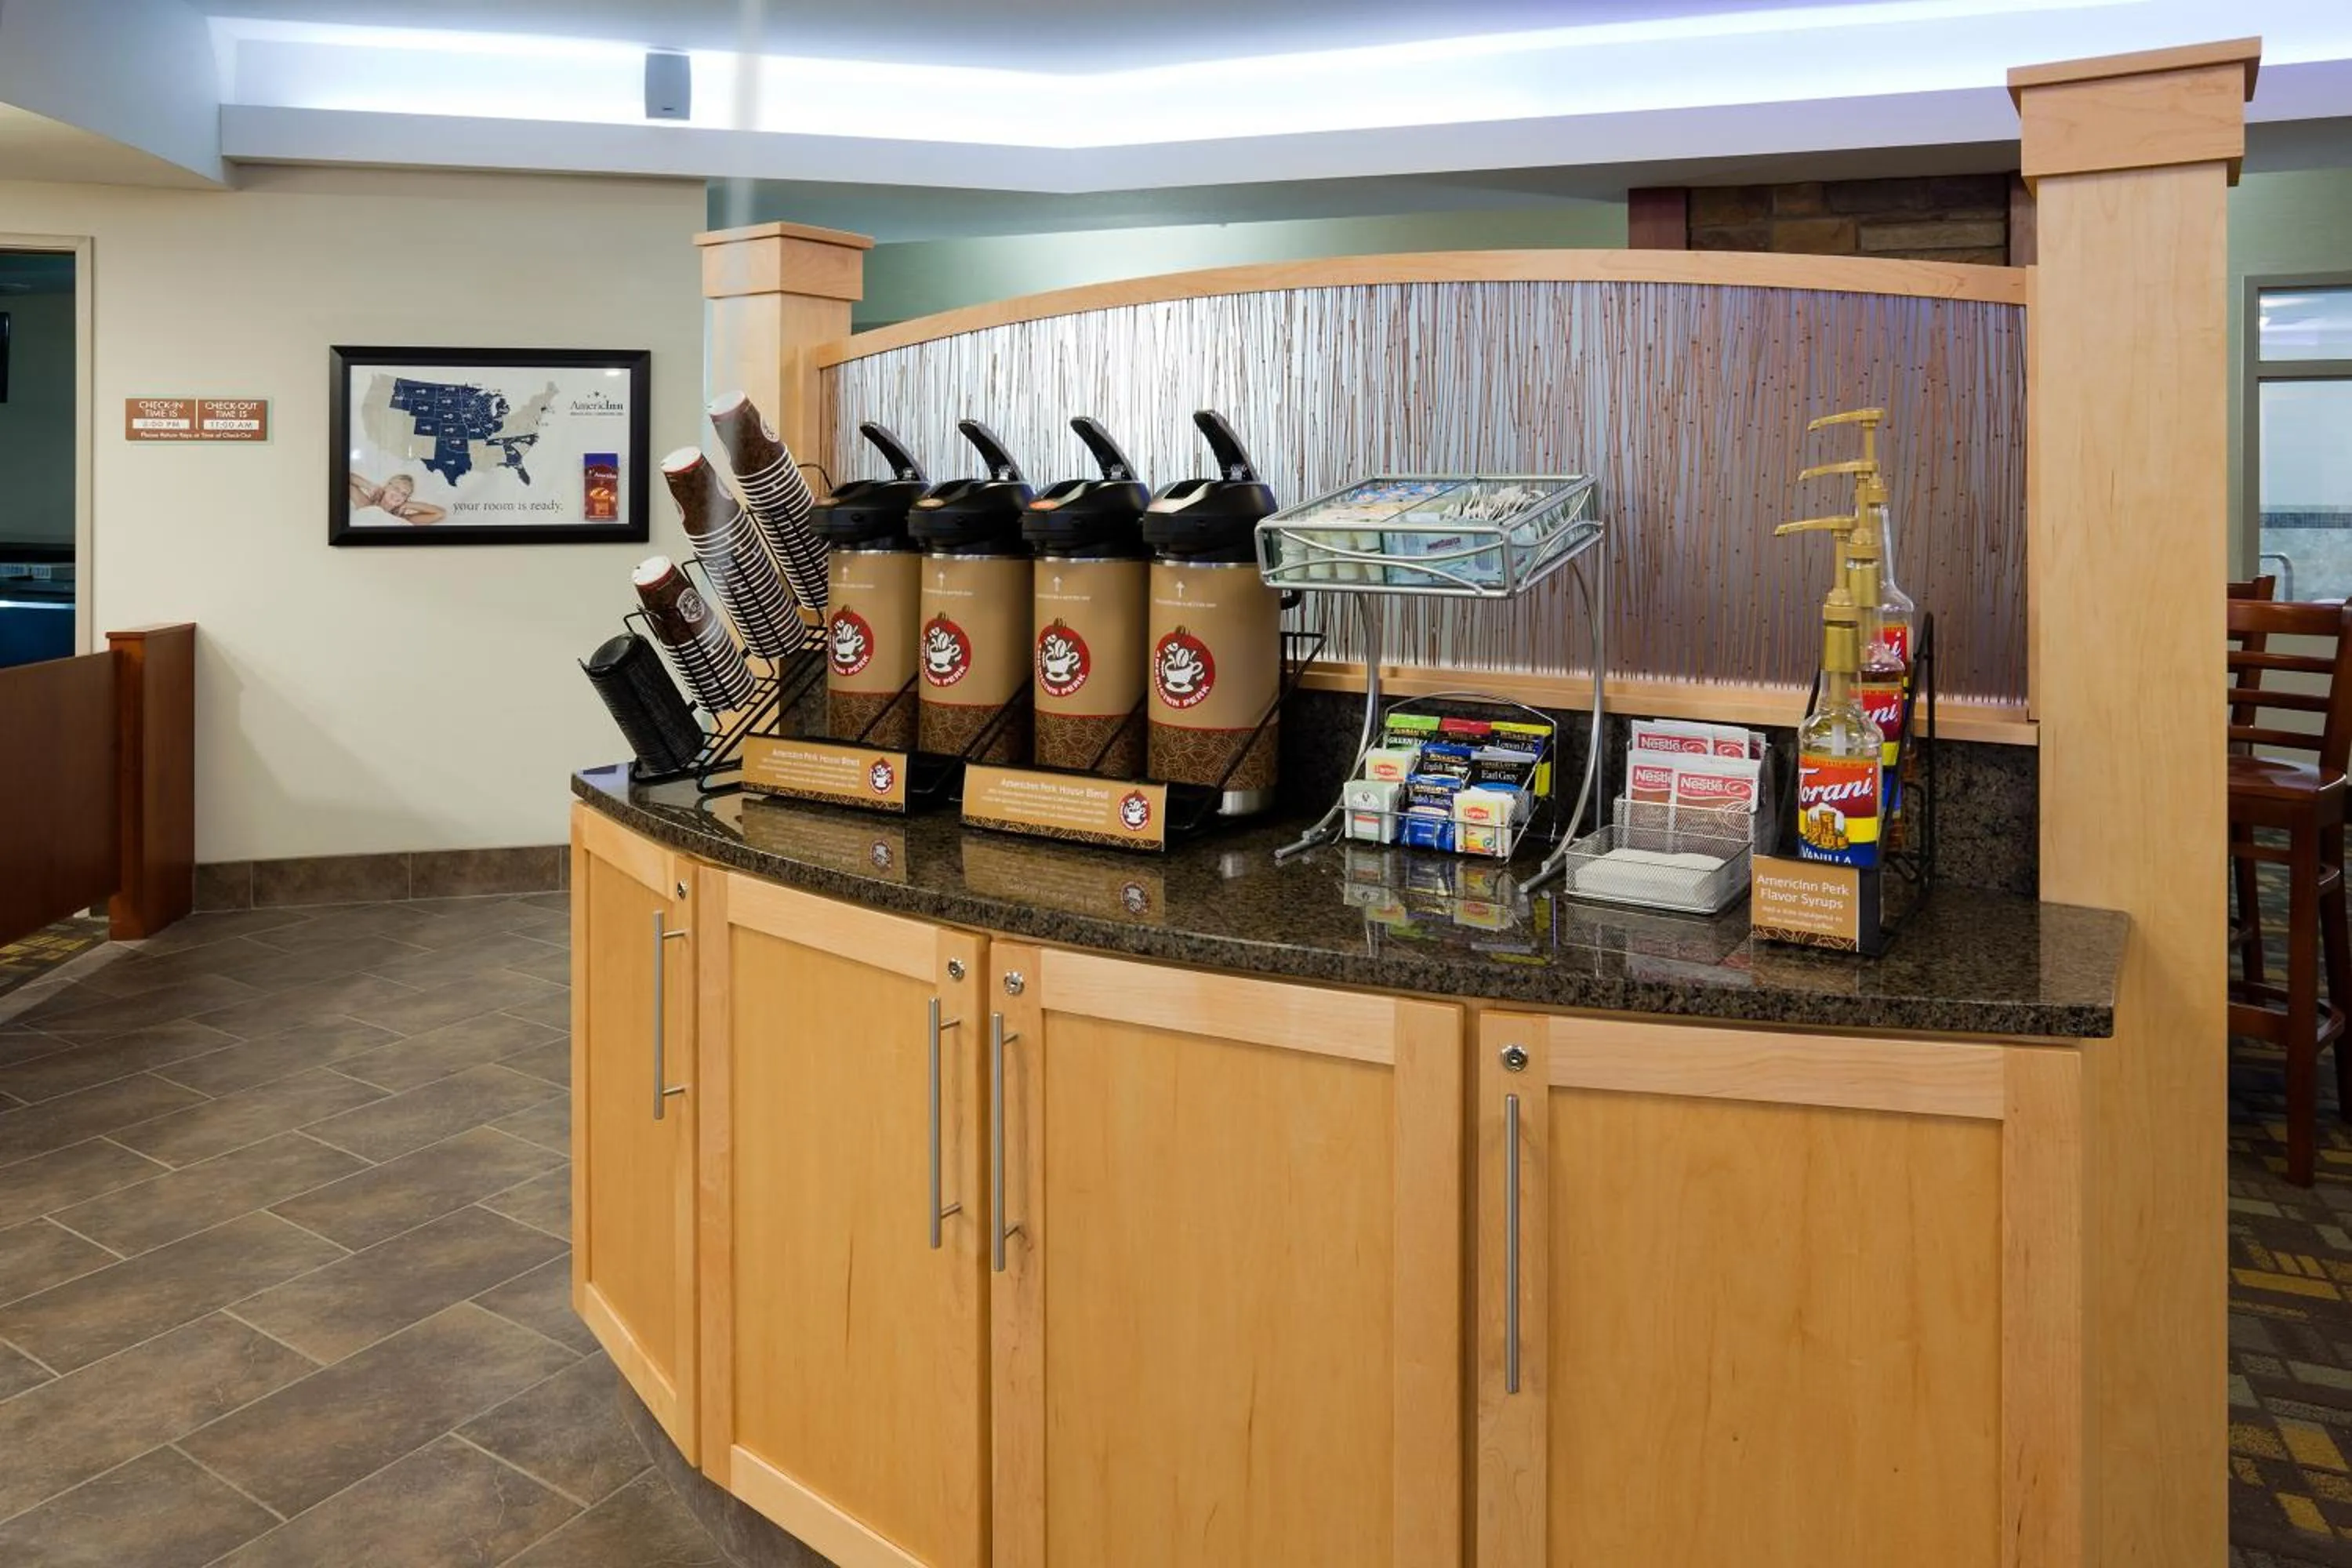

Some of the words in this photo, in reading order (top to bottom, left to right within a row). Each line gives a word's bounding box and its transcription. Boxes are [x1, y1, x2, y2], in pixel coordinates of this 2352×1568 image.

[139, 401, 184, 409] CHECK-IN
[205, 401, 258, 410] CHECK-OUT
[570, 400, 623, 410] AmericInn
[452, 502, 481, 514] your
[483, 502, 514, 510] room
[518, 501, 528, 510] is
[942, 666, 967, 686] PERK
[1061, 673, 1086, 695] PERK
[1183, 684, 1210, 706] PERK
[1481, 770, 1498, 779] Earl
[1498, 771, 1519, 782] Grey
[1059, 785, 1084, 797] House
[1086, 788, 1109, 800] Blend
[1798, 768, 1873, 802] Torani
[1756, 874, 1818, 891] AmericInn
[1821, 882, 1849, 896] Perk
[1760, 887, 1798, 903] Flavor
[1801, 893, 1843, 910] Syrups
